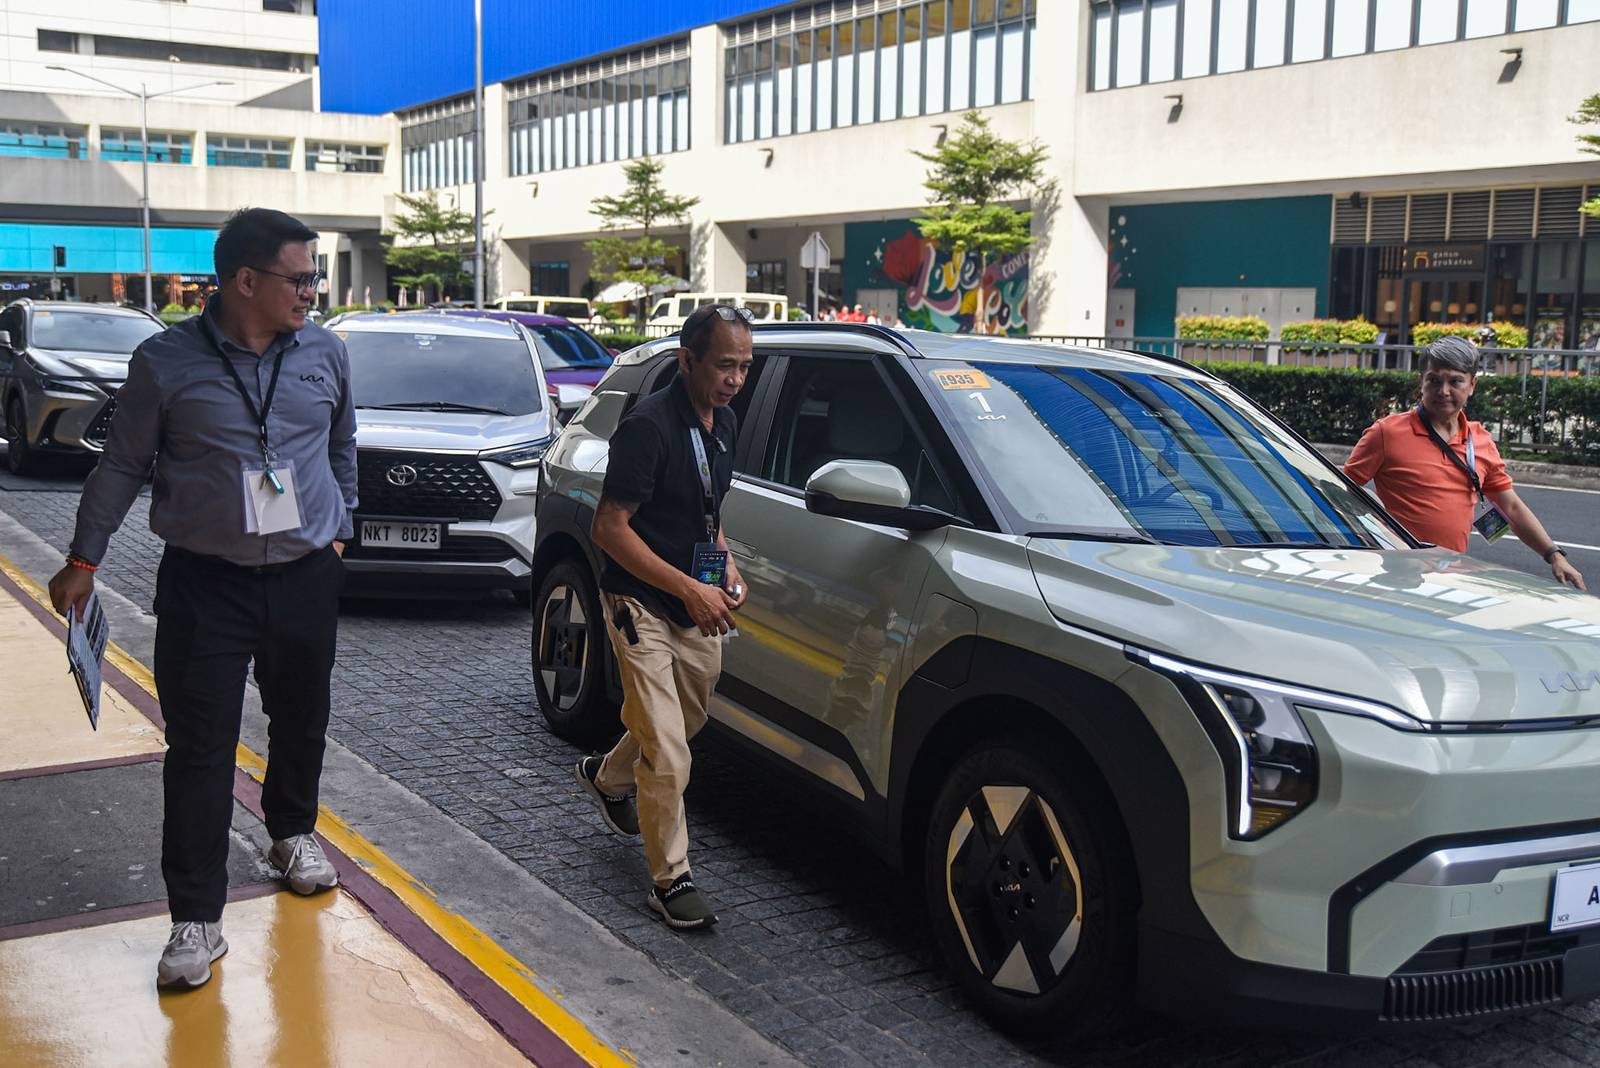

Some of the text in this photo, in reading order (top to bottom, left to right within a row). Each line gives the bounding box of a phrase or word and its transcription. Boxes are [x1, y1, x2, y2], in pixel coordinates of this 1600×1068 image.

[968, 391, 993, 413] 1
[363, 524, 438, 543] NKT 8023
